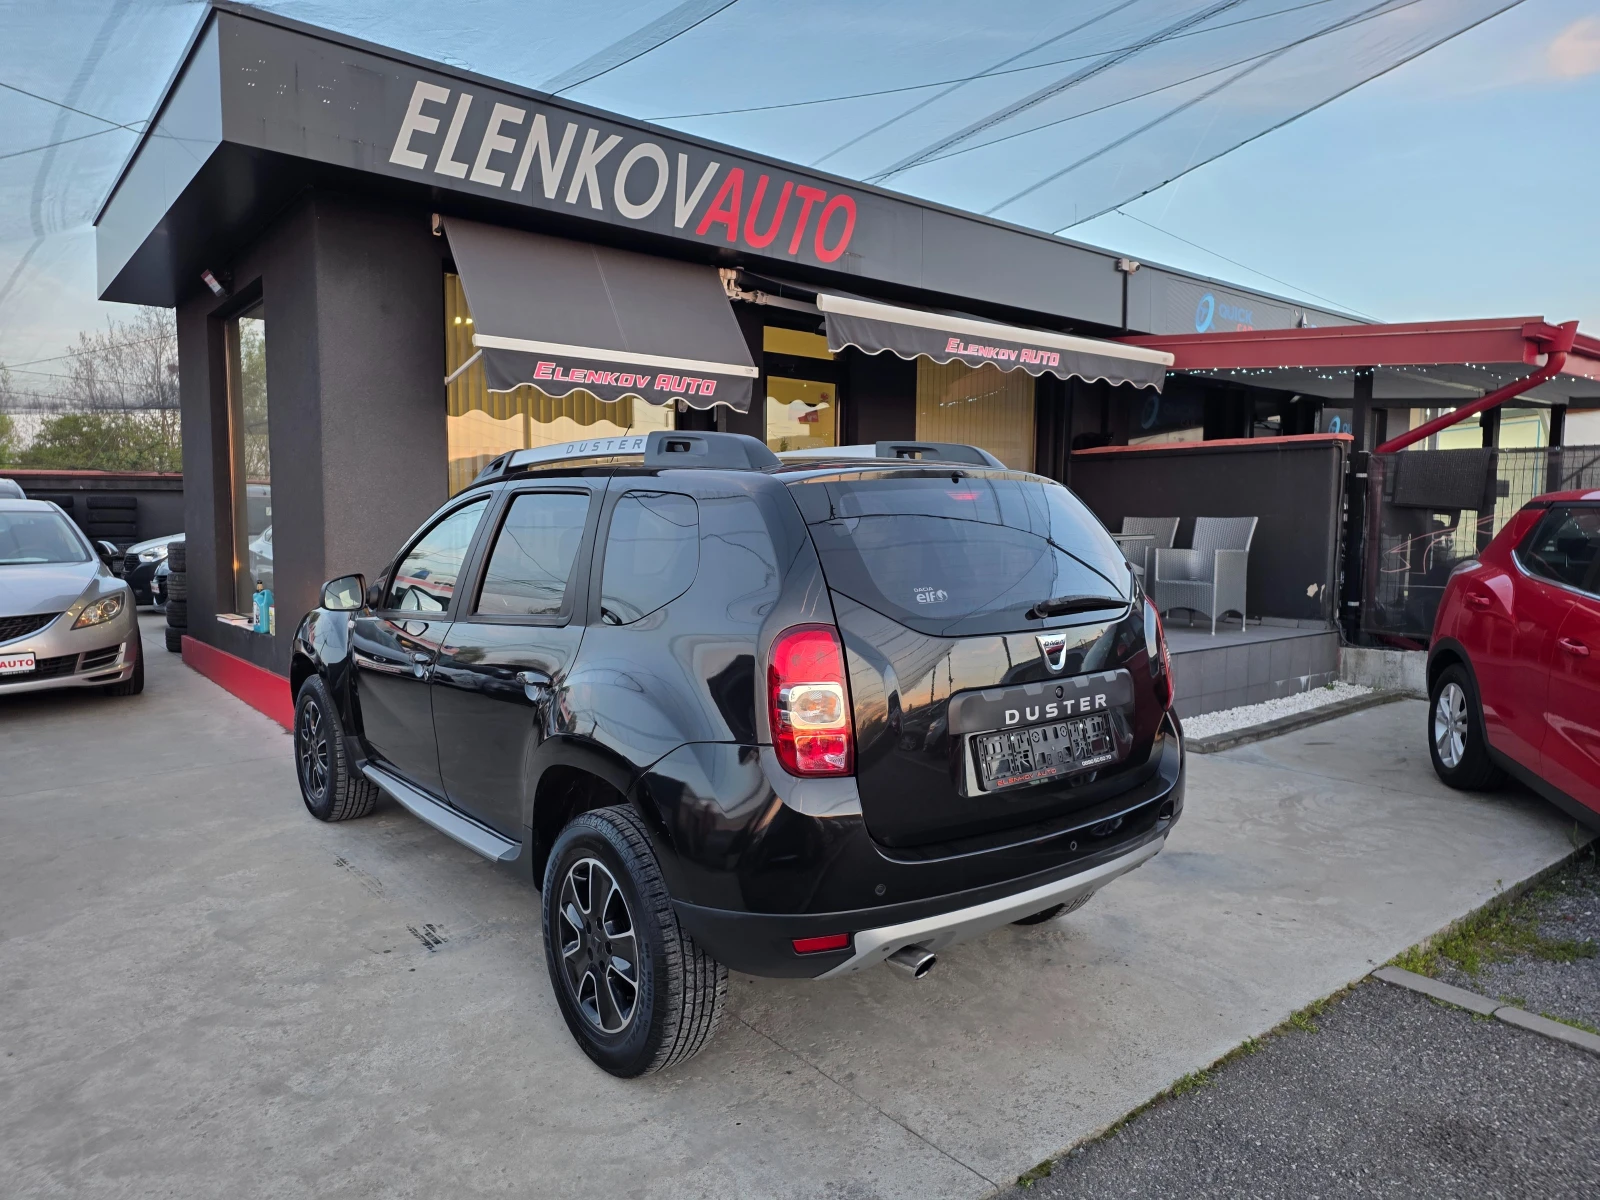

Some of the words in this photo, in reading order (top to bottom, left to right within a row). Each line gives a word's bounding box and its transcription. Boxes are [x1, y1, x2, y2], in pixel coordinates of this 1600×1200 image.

[1219, 303, 1253, 324] QUICK
[945, 337, 1018, 361] ELENKOV
[1020, 348, 1060, 367] AUTO
[533, 361, 651, 388] ELENKOV
[654, 373, 717, 396] AUTO
[566, 438, 643, 454] DUSTER
[916, 591, 936, 603] elf
[0, 659, 34, 668] AUTO
[1005, 693, 1107, 725] DUSTER
